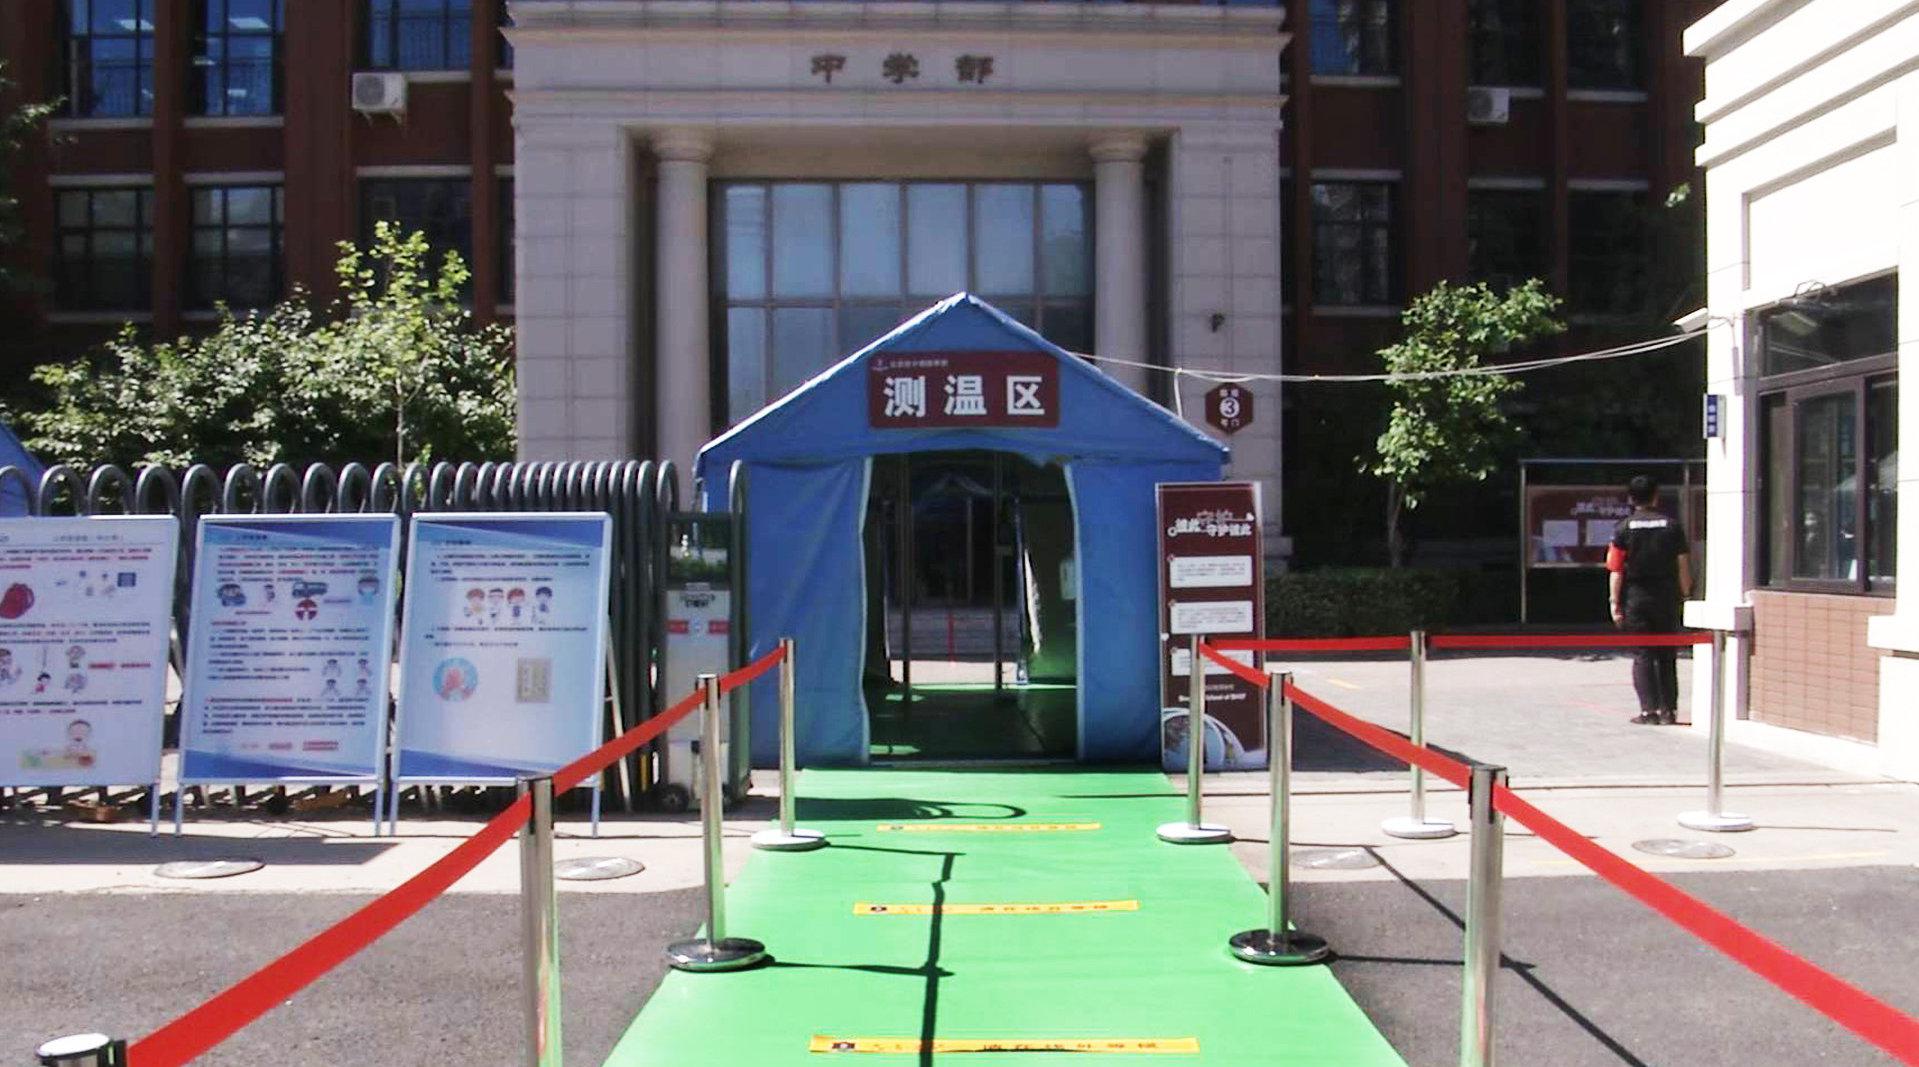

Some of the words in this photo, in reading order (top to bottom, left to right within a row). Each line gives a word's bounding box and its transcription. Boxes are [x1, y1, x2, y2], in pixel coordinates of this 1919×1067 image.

[811, 52, 994, 84] 中学部
[883, 375, 1045, 417] 测温区
[1224, 399, 1236, 415] 3
